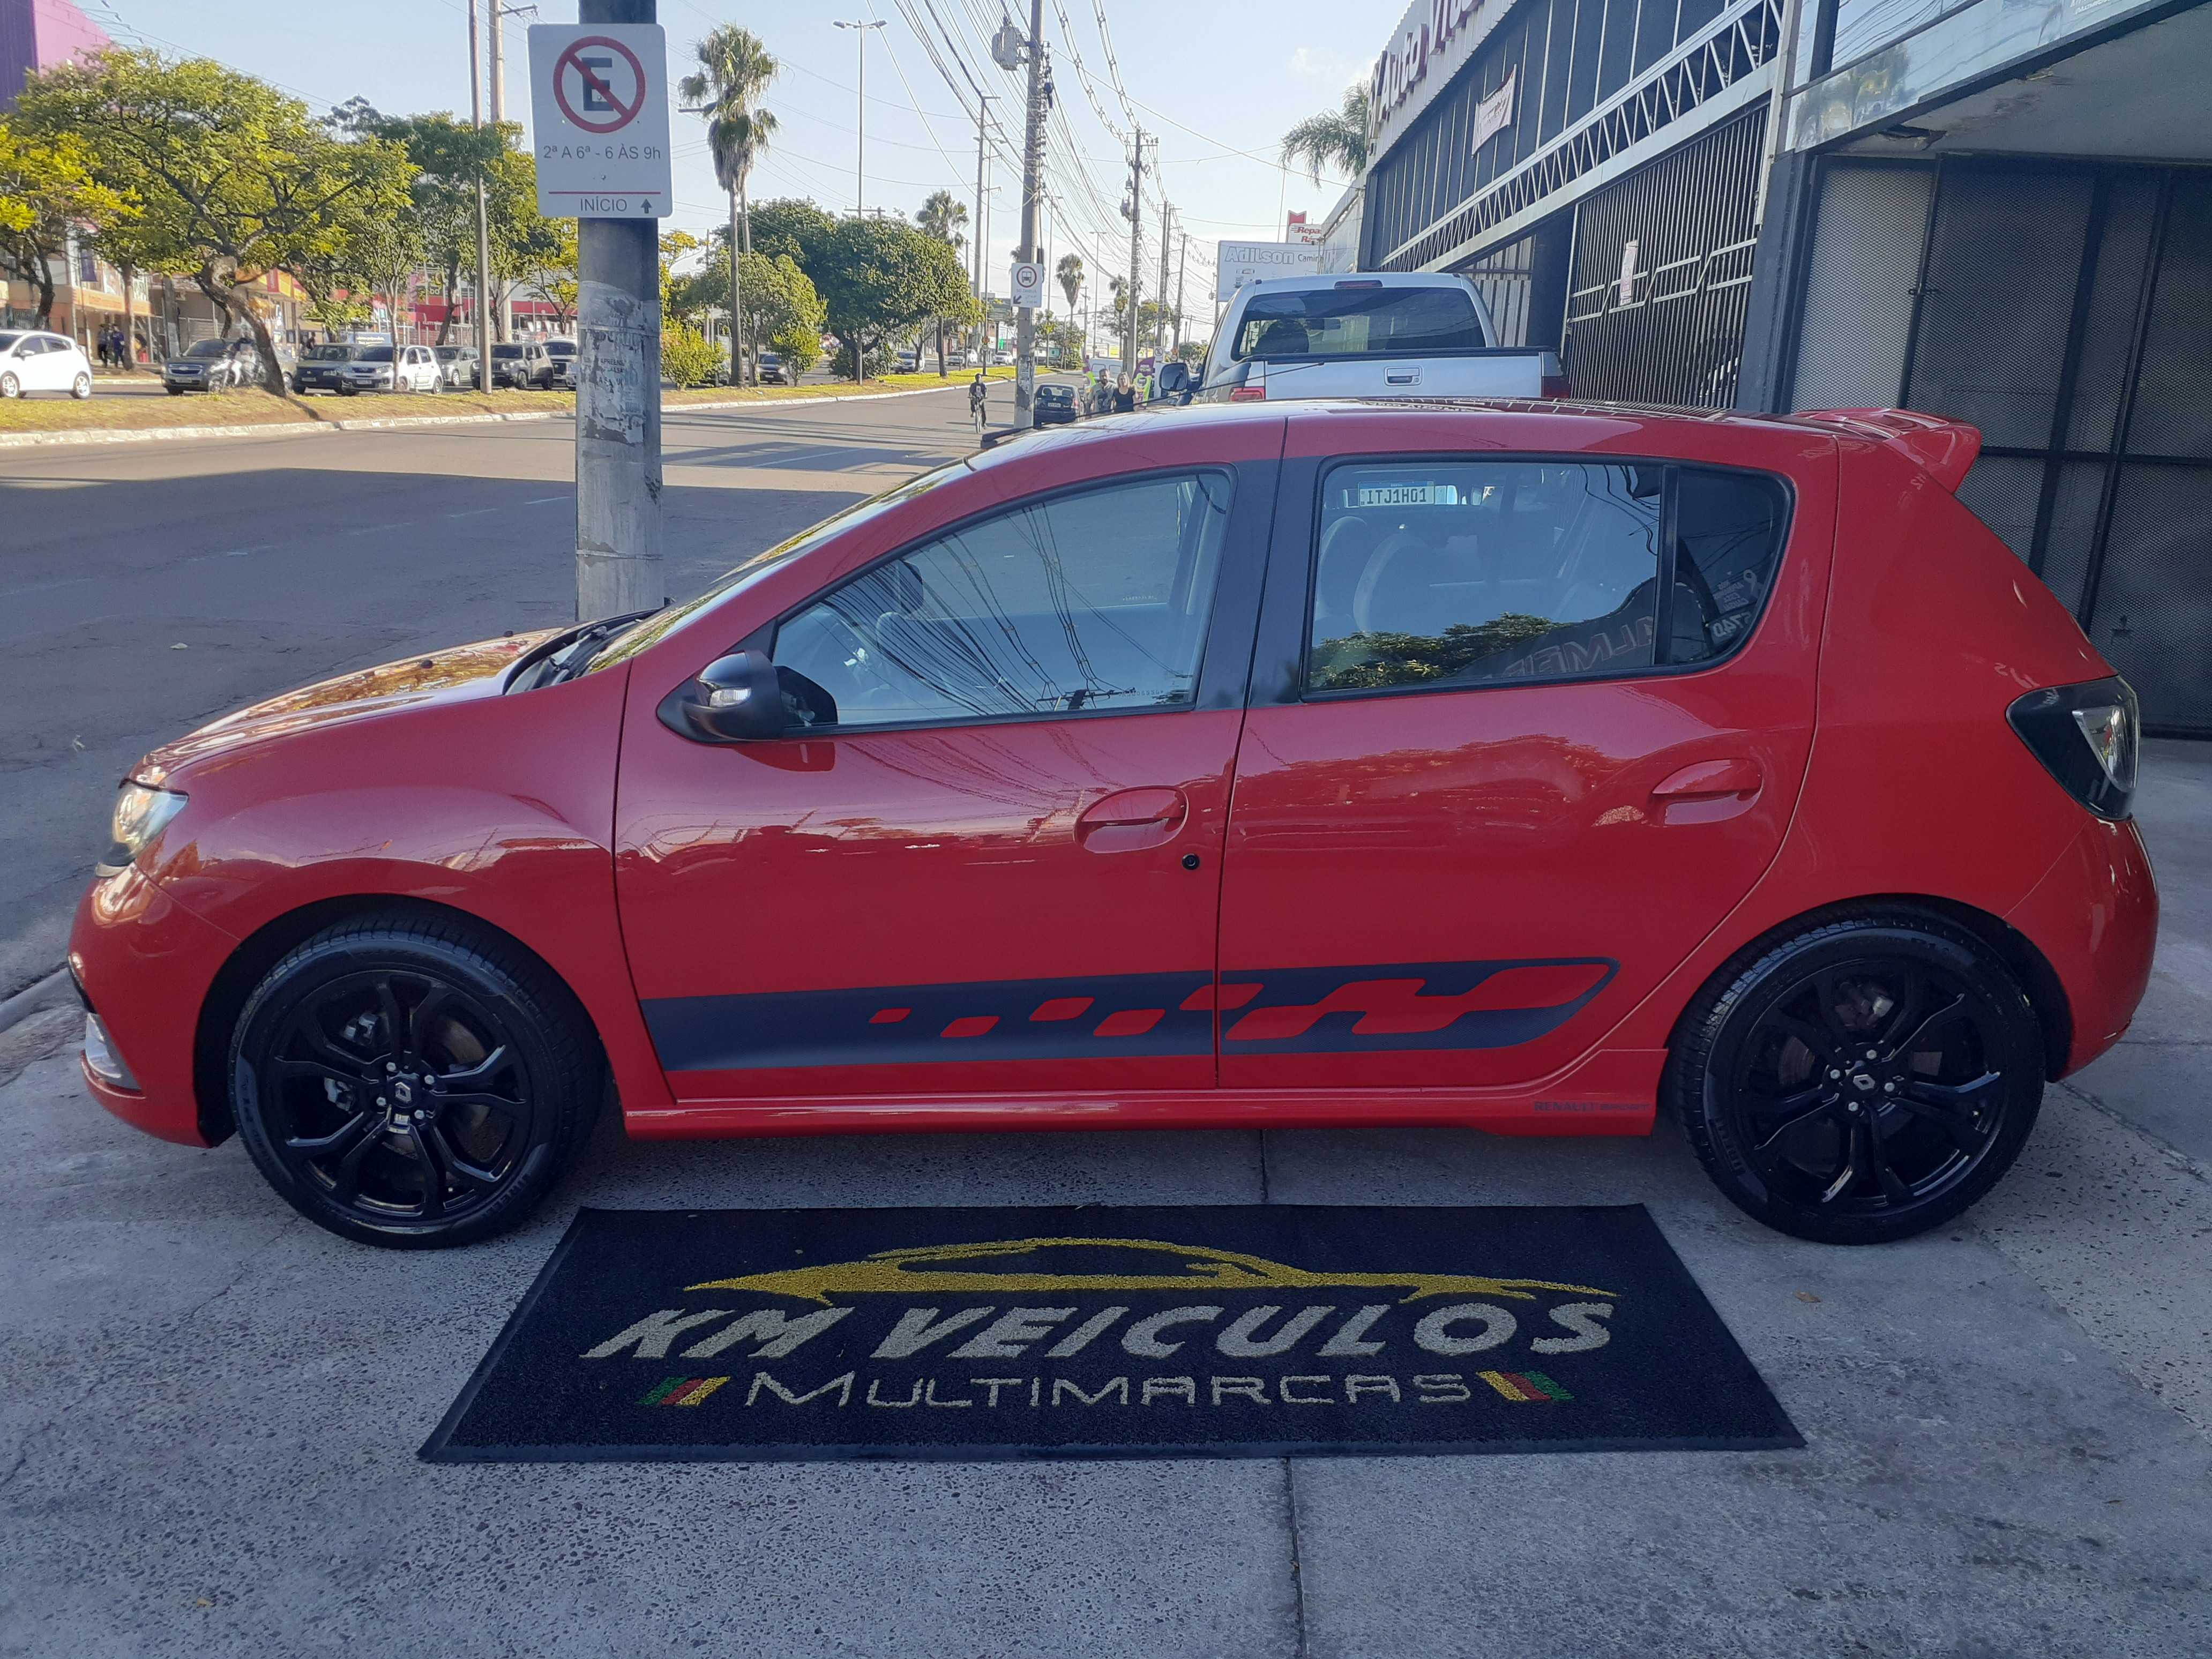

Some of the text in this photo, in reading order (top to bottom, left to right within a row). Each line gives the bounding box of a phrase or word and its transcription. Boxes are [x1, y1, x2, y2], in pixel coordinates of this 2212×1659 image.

[561, 146, 573, 159] A
[604, 146, 614, 159] 6
[618, 143, 639, 159] ÀS
[644, 146, 661, 160] 9h
[580, 196, 627, 212] INÍCIO
[1224, 246, 1295, 265] Adilson
[579, 1302, 1615, 1358] KM VEICULOS
[744, 1370, 1471, 1408] MULTIMARCAS
